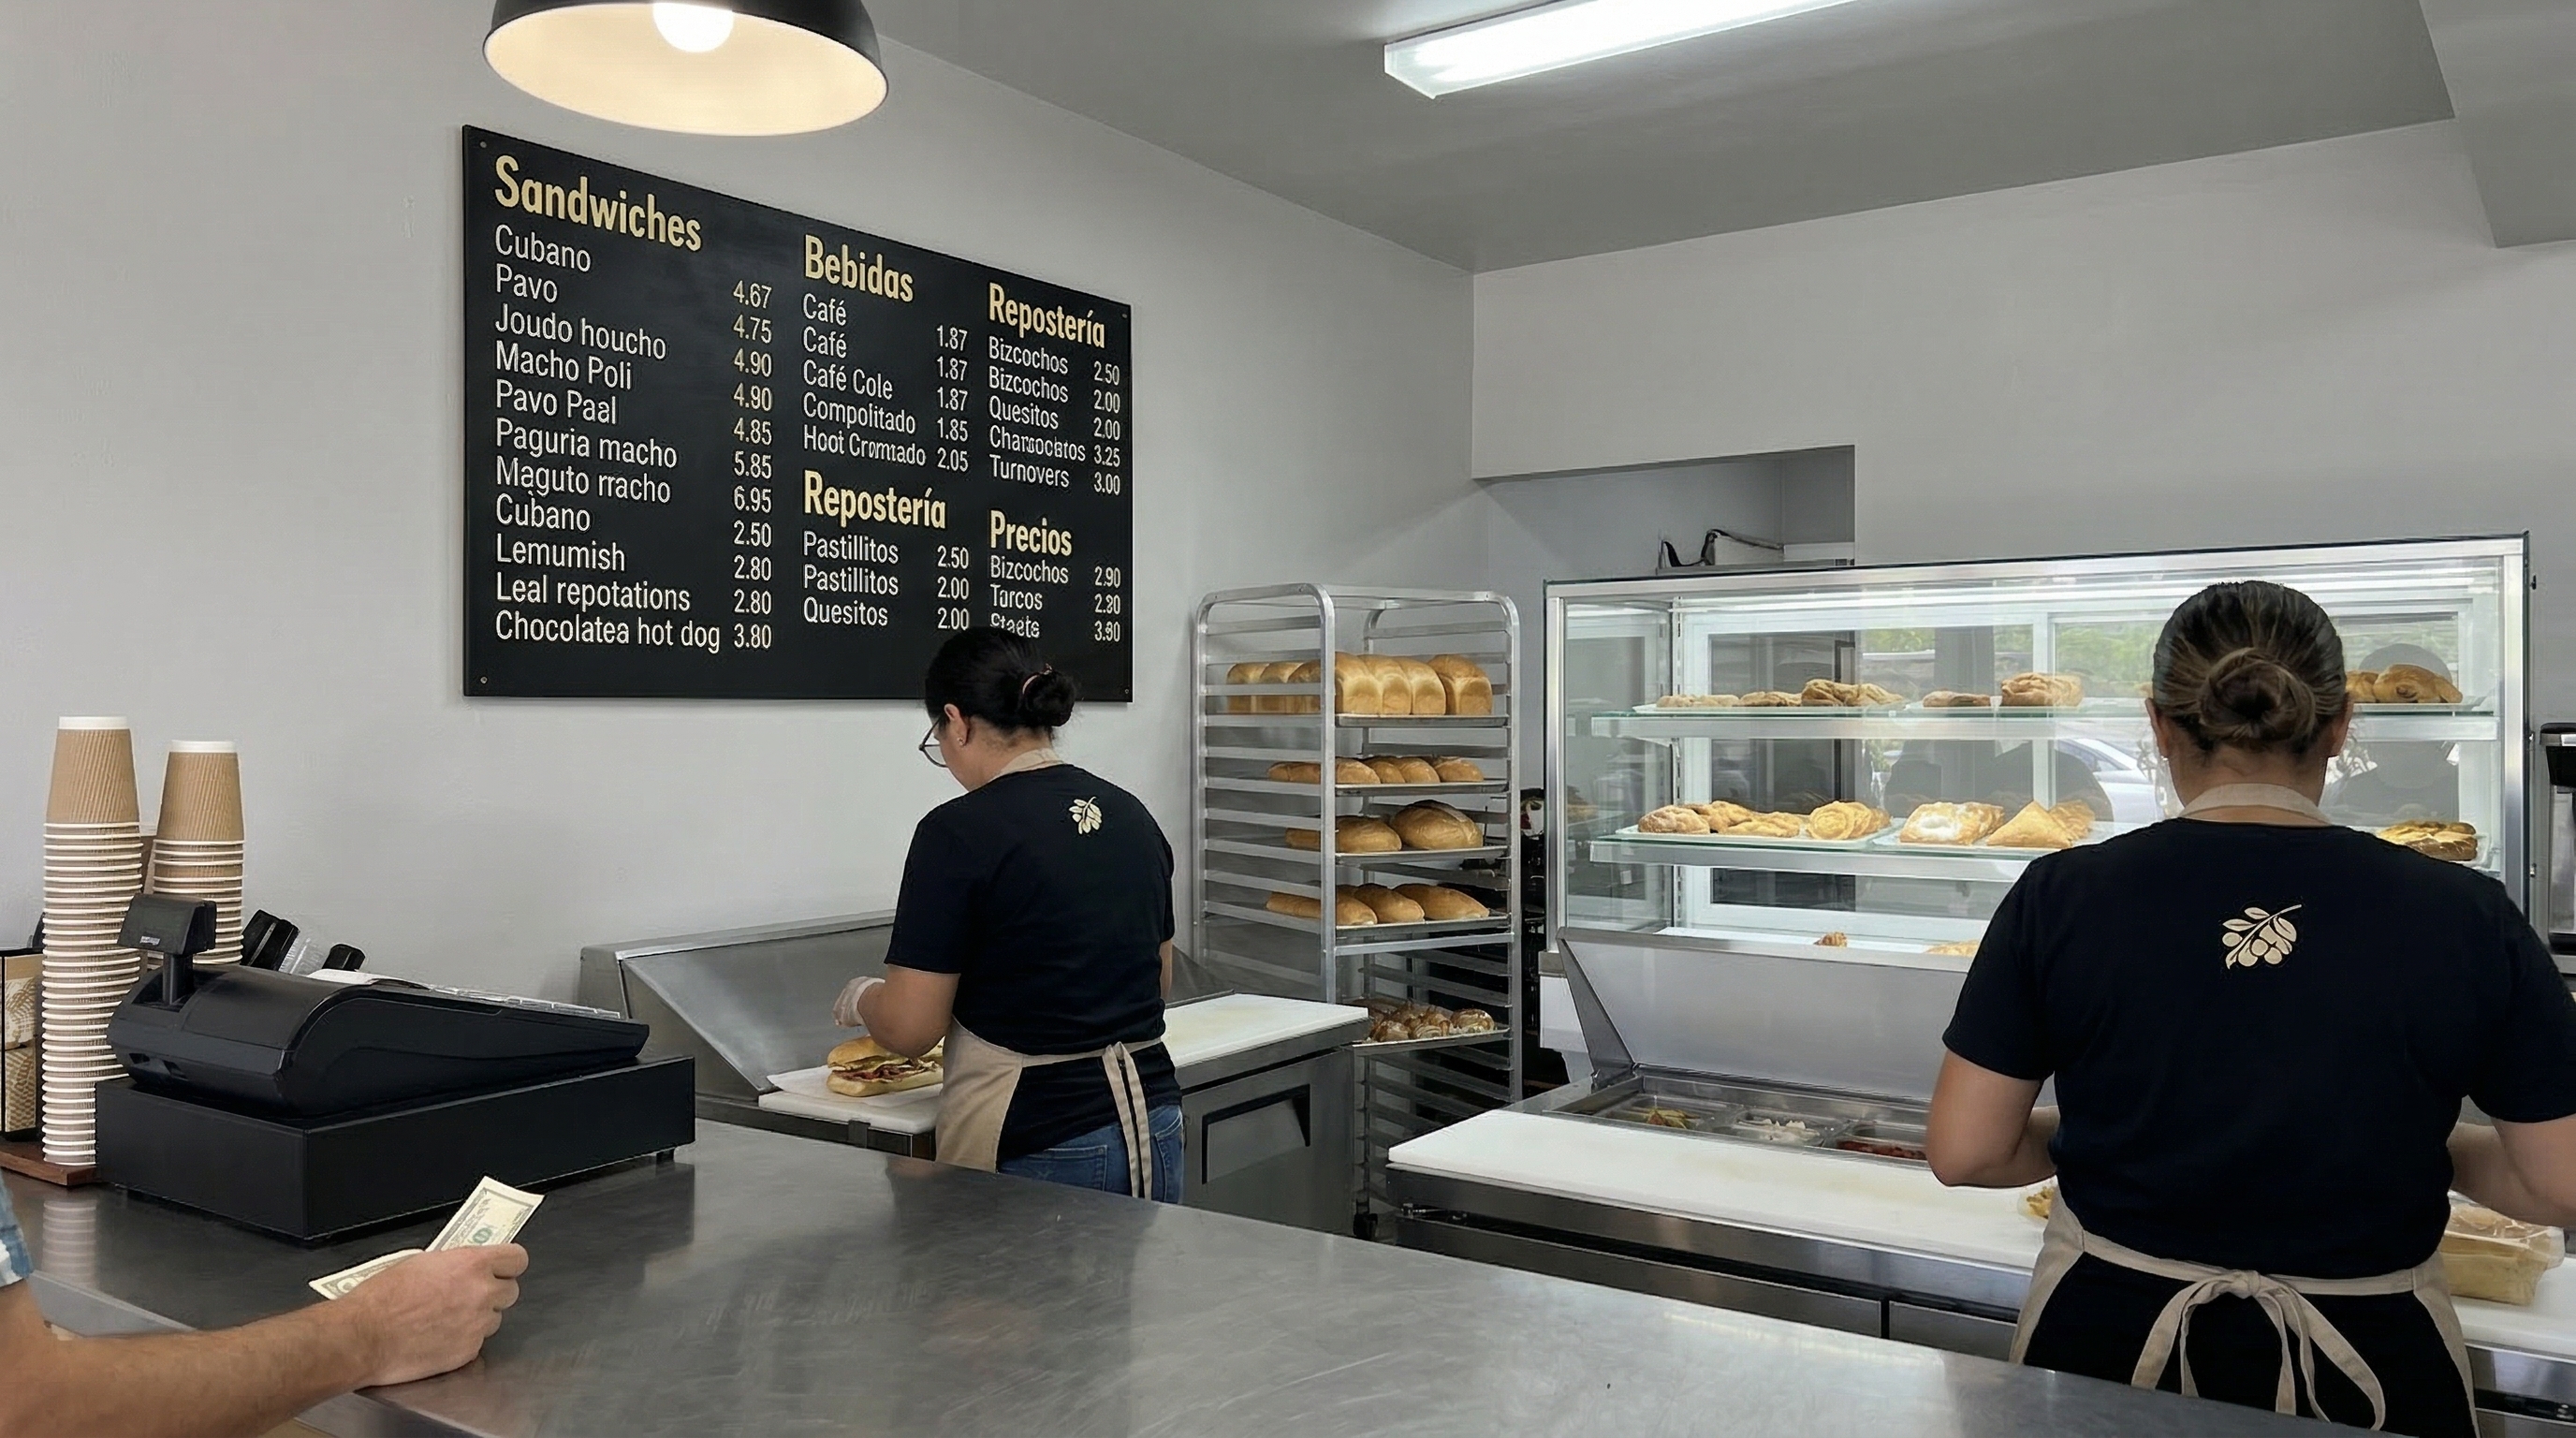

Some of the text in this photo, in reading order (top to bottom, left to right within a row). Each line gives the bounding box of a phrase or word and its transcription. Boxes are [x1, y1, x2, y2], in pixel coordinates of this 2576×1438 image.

[494, 154, 702, 251] Sandwiches
[495, 225, 772, 309] Cubano 4.67
[804, 234, 914, 302] Bebidas
[496, 263, 772, 344] Pavo 4.75
[802, 293, 968, 352] Café 1.87
[988, 282, 1105, 349] Repostería
[495, 303, 772, 377] Joudo houcho 4.90
[802, 326, 968, 382] Café 1.87
[988, 335, 1120, 387] Bizcochos 2.50
[496, 340, 772, 412] Macho Poli 4.90
[802, 359, 968, 412] Café Cole 1.87
[988, 365, 1120, 414] Bizcochos 2.00
[496, 379, 772, 446] Pavo Paal 4.85
[936, 417, 968, 443] 1.85
[989, 395, 1120, 441] Quesitos 2.00
[496, 418, 772, 479] Paguria macho 5.85
[803, 424, 844, 455] Hoot
[937, 448, 969, 473] 2.05
[1093, 444, 1120, 468] 3.25
[496, 455, 590, 498] Maguto
[733, 485, 772, 513] 6.95
[804, 469, 946, 530] Repostería
[989, 454, 1120, 496] Turnovers 3.00
[496, 493, 772, 548] Cubano 2.50
[990, 509, 1072, 557] Precios
[496, 533, 772, 581] Lemumish 2.80
[803, 530, 969, 569] Pastillitos 2.50
[990, 555, 1069, 584] Bizcochos
[496, 571, 772, 615] Leal repotations 2.80
[803, 564, 970, 600] Pastillitos 2.00
[495, 609, 772, 654] Chocolatea hot dog 3.80
[803, 596, 970, 631] Quesitos 2.00
